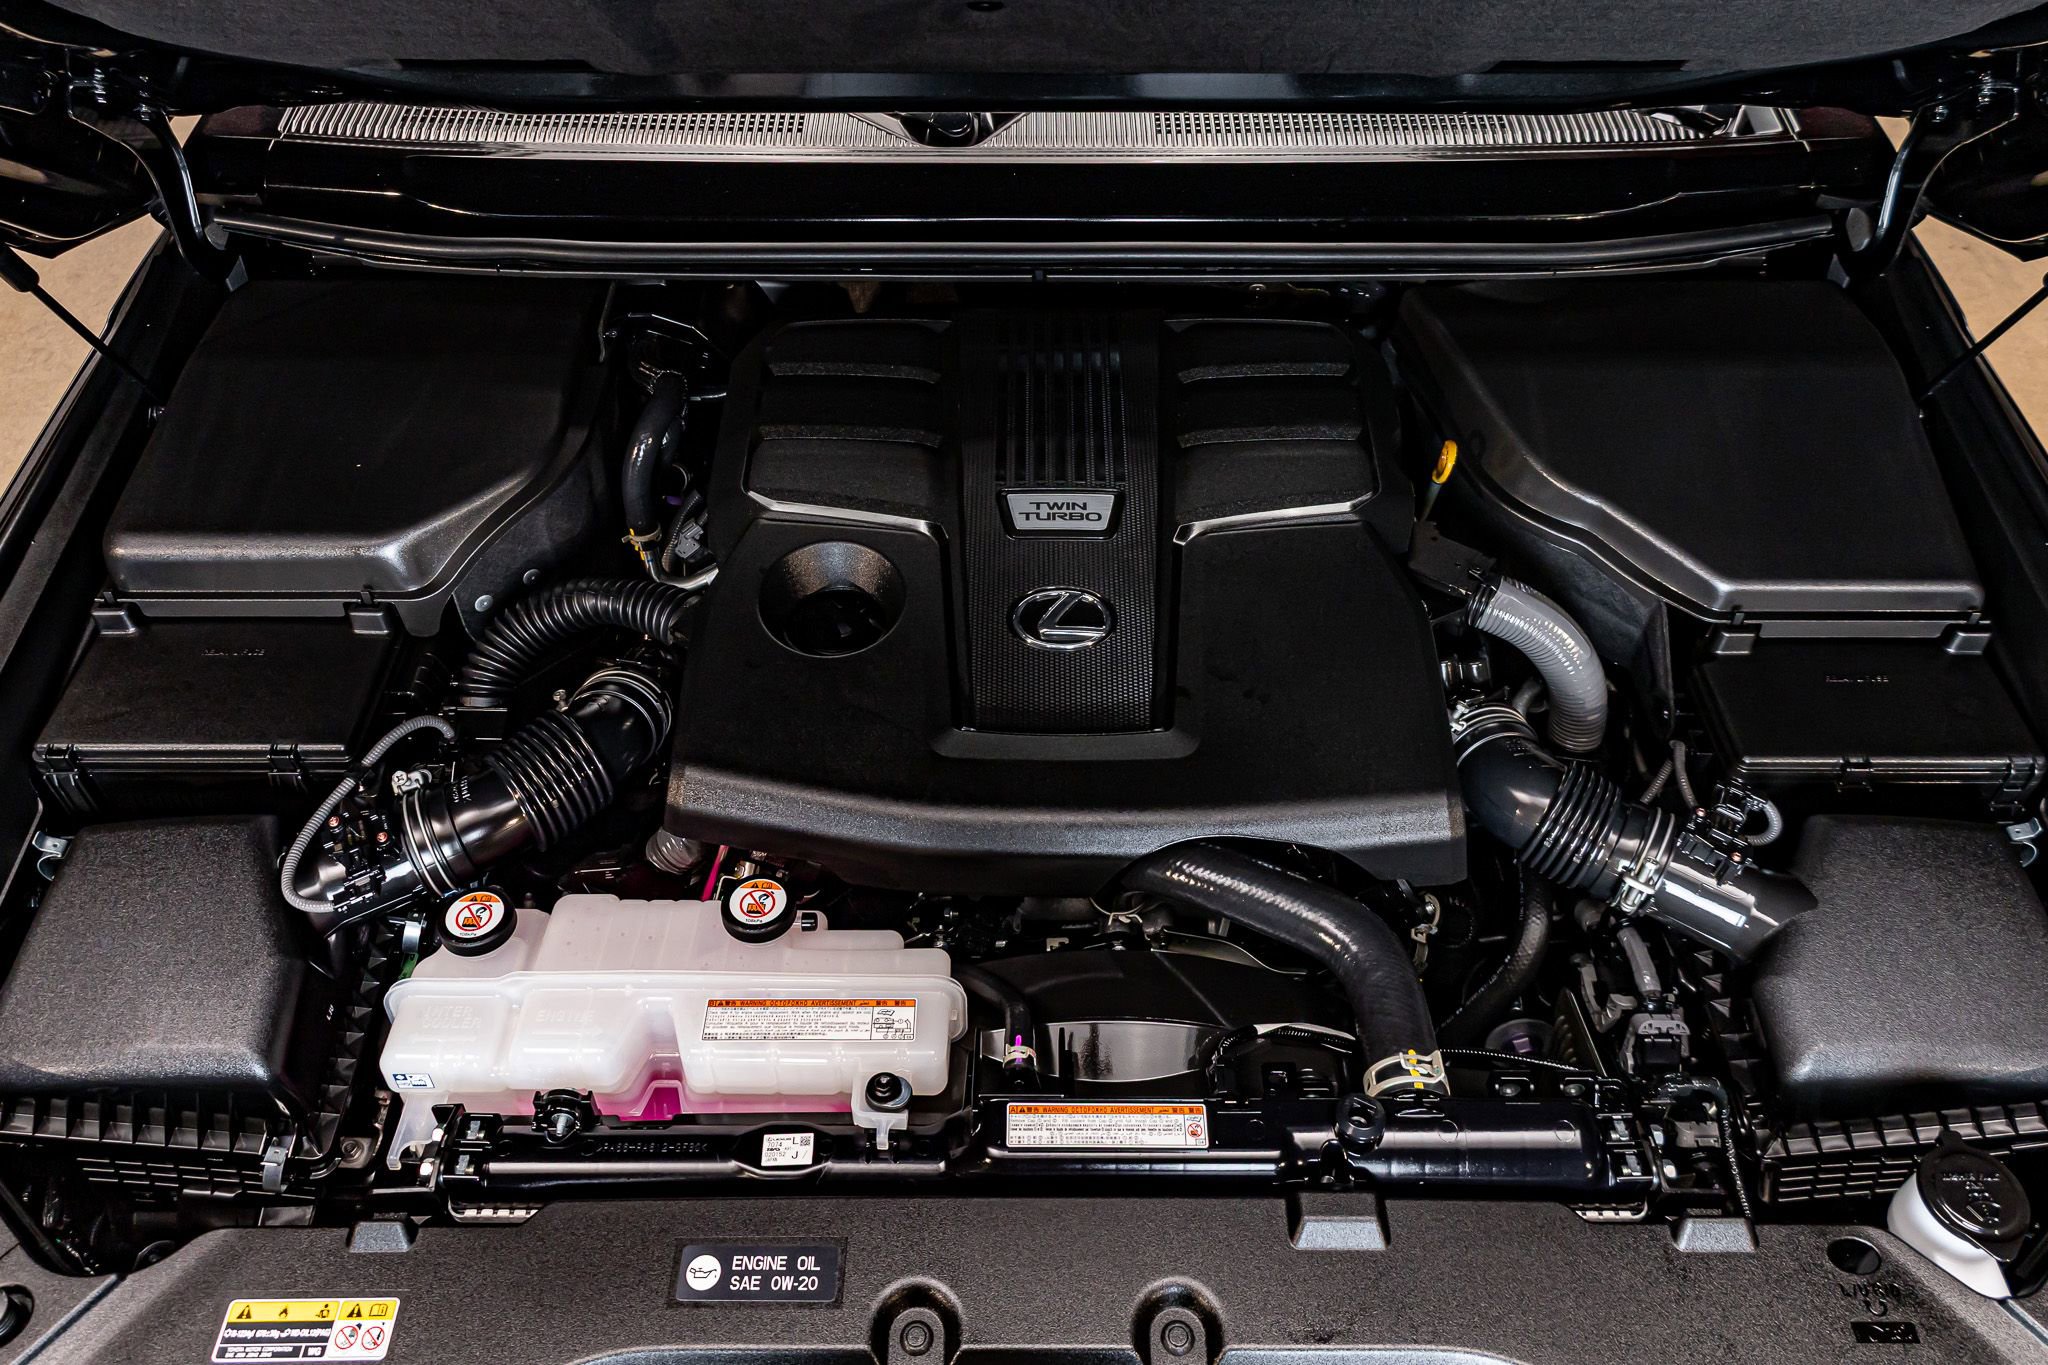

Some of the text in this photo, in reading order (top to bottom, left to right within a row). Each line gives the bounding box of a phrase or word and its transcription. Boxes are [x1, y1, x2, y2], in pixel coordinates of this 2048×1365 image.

[1029, 501, 1088, 511] TWIN
[1018, 512, 1102, 521] TURBO
[535, 1009, 596, 1023] ENGINE
[792, 1136, 799, 1145] L
[791, 1151, 799, 1159] J
[732, 1256, 821, 1270] ENGINE OIL
[729, 1276, 819, 1291] SAE 0W-20
